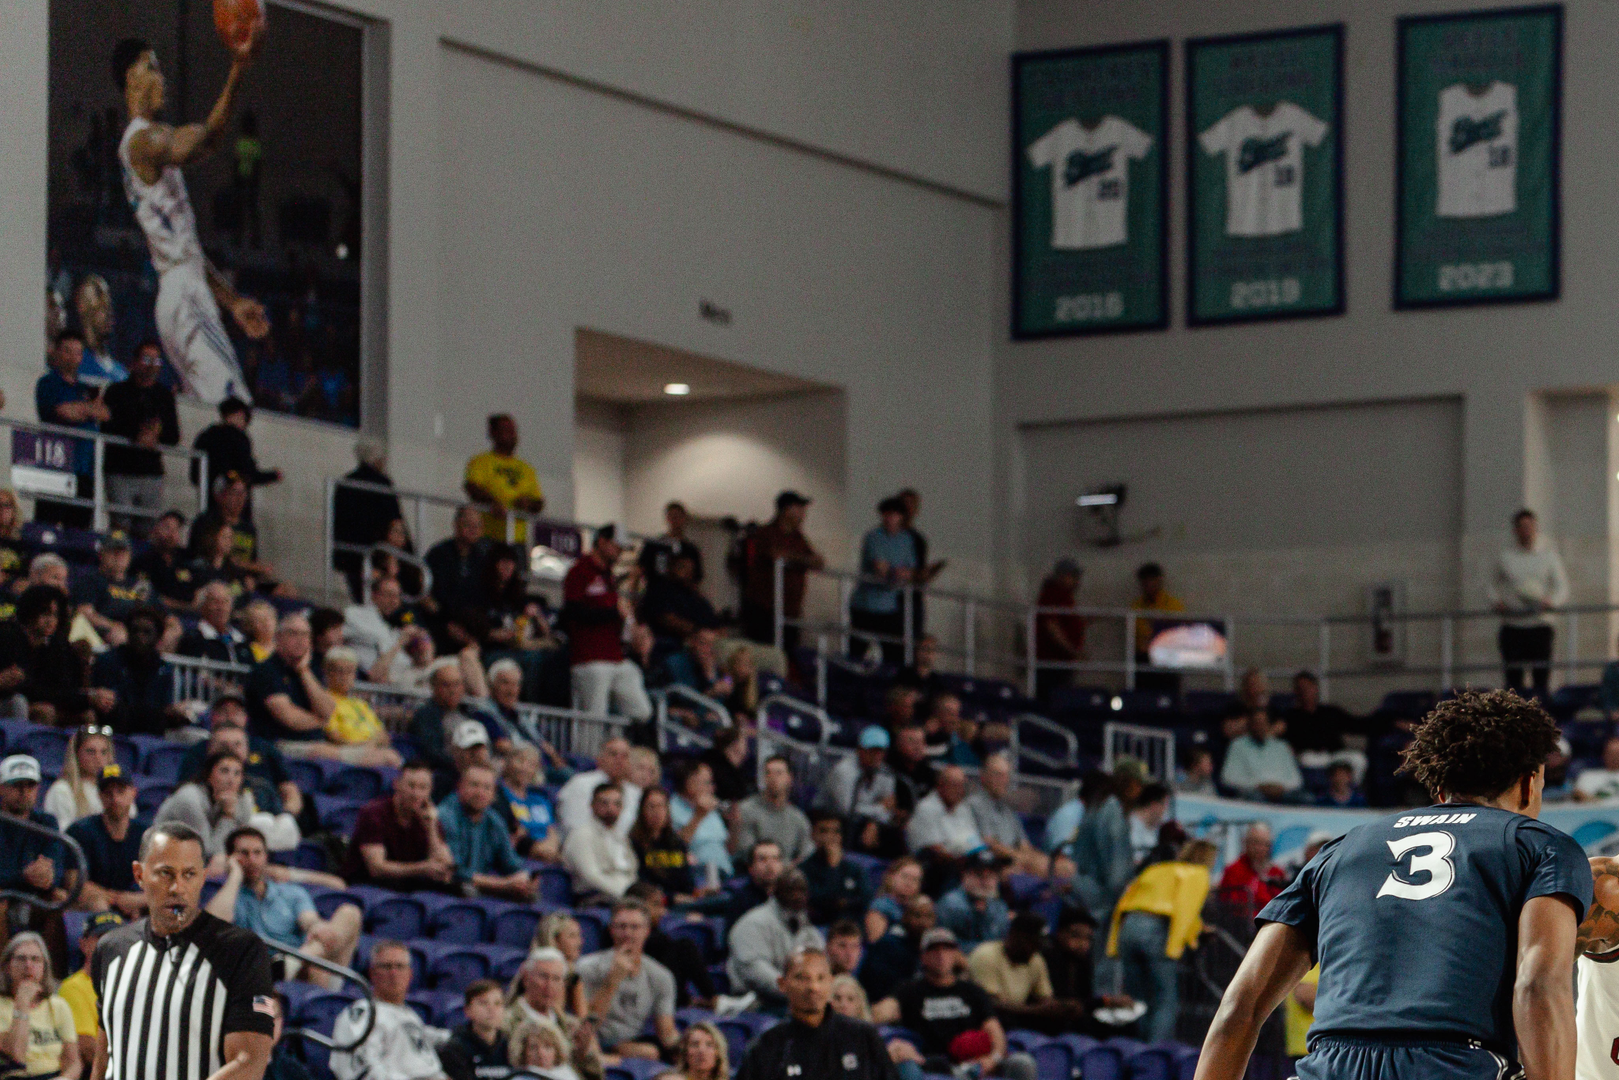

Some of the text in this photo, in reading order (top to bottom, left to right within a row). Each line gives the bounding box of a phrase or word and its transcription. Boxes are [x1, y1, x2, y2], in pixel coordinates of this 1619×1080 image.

[1438, 261, 1514, 291] 2023
[1393, 813, 1477, 829] SWAIN
[1375, 830, 1457, 901] 3
